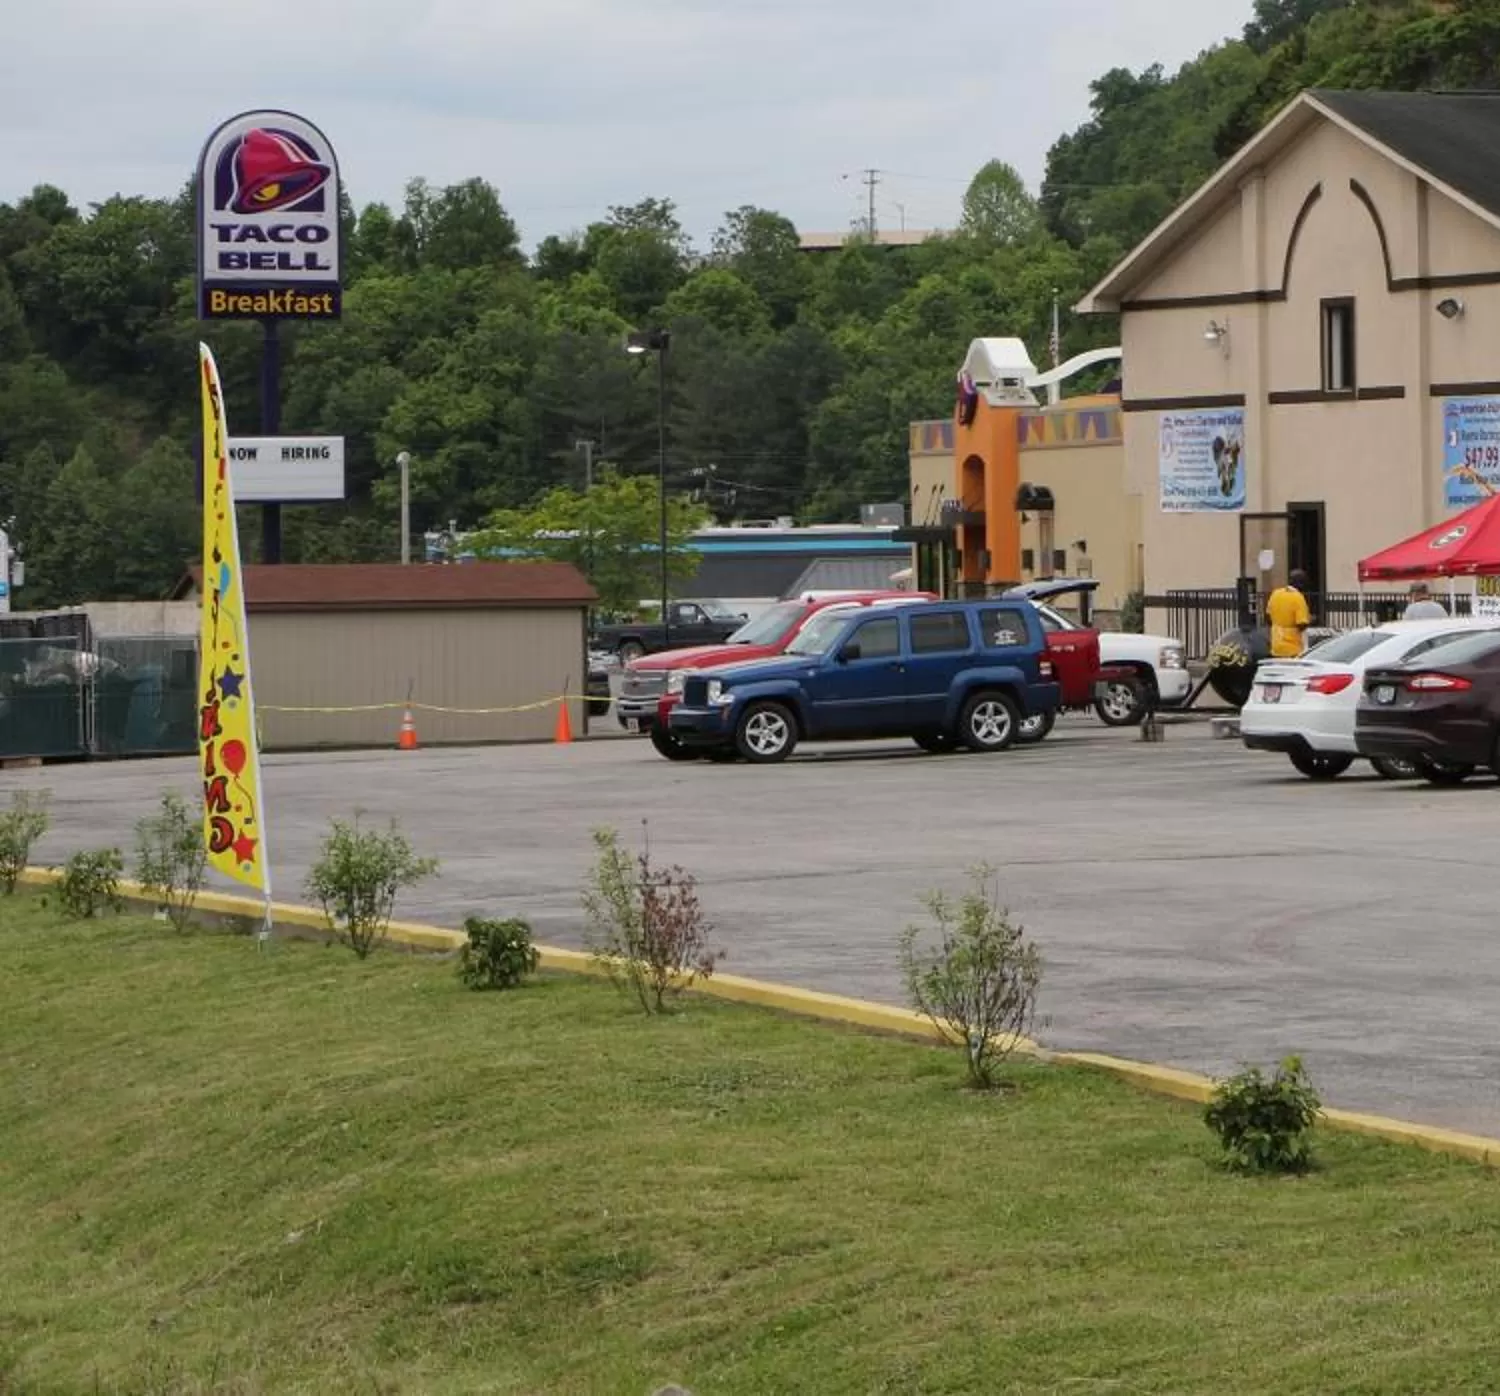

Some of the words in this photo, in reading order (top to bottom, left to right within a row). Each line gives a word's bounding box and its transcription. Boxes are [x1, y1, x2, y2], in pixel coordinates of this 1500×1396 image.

[210, 224, 330, 245] TACO
[218, 252, 332, 271] BELL
[211, 288, 333, 313] Breakfast
[229, 447, 258, 461] NOW
[281, 446, 331, 460] HIRING
[1465, 446, 1499, 468] $47.99
